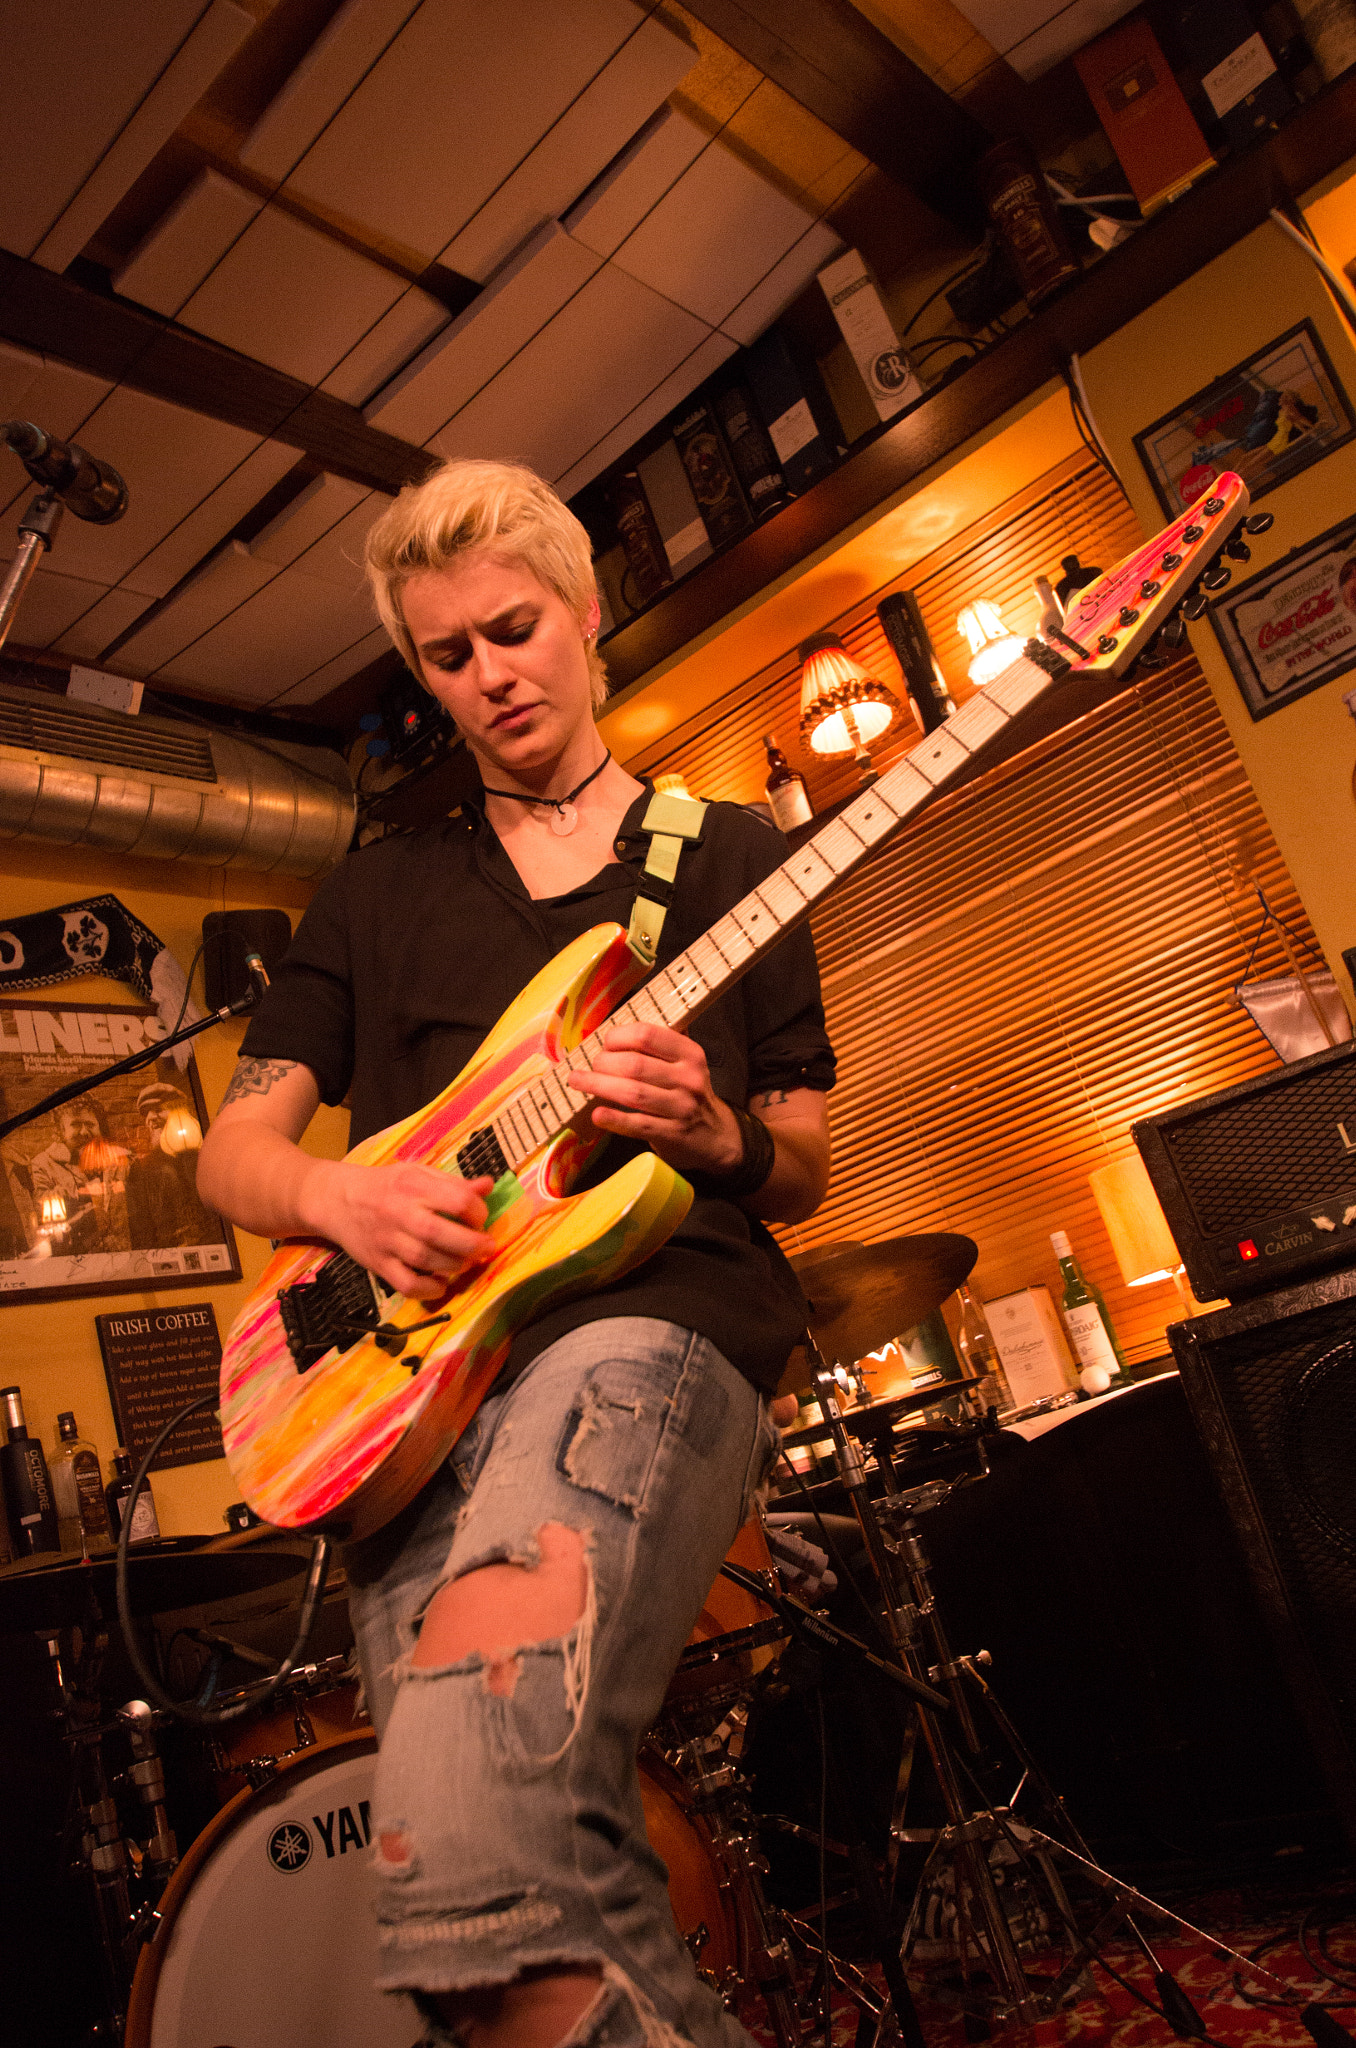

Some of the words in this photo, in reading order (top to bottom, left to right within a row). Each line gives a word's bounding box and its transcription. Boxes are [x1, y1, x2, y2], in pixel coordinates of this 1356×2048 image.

[1314, 625, 1352, 651] WORLD
[1264, 1231, 1314, 1256] CARVIN
[109, 1317, 152, 1338] IRISH
[155, 1311, 210, 1332] COFFEE
[29, 1449, 50, 1512] OCTOMORE
